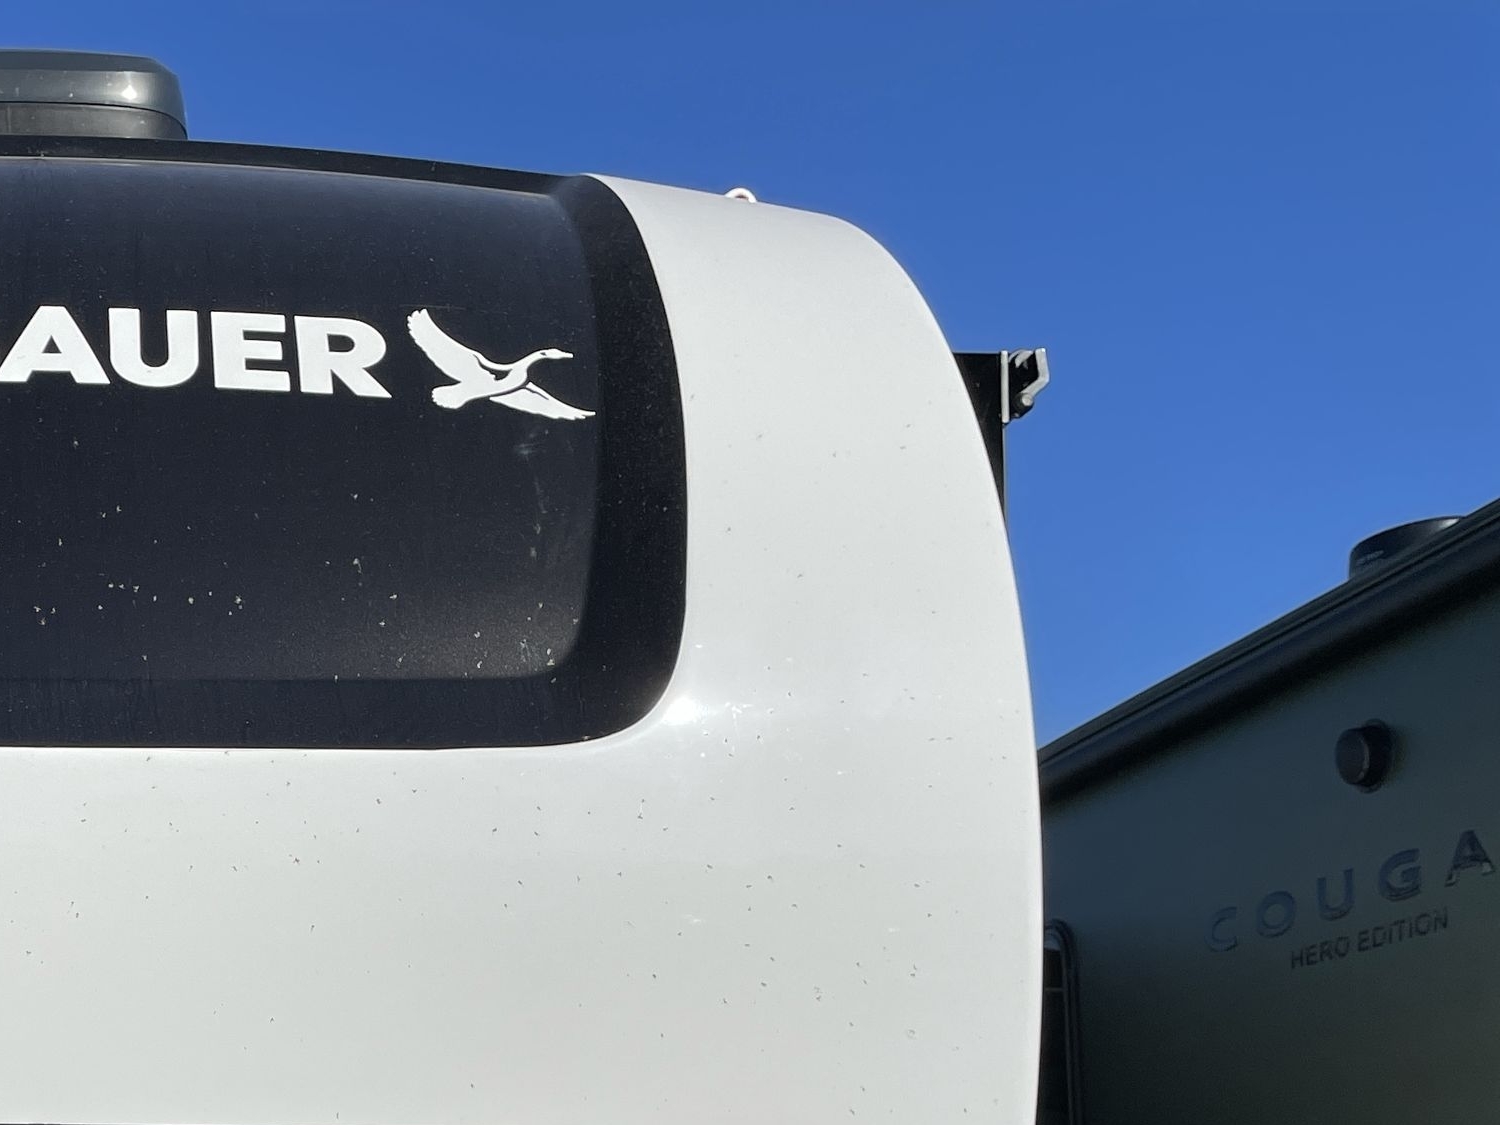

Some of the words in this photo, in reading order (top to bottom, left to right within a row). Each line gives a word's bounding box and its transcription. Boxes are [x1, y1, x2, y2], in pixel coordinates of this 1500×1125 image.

[1204, 829, 1496, 952] COUGA
[1290, 936, 1350, 970] HERO
[1357, 906, 1449, 952] EDITION
